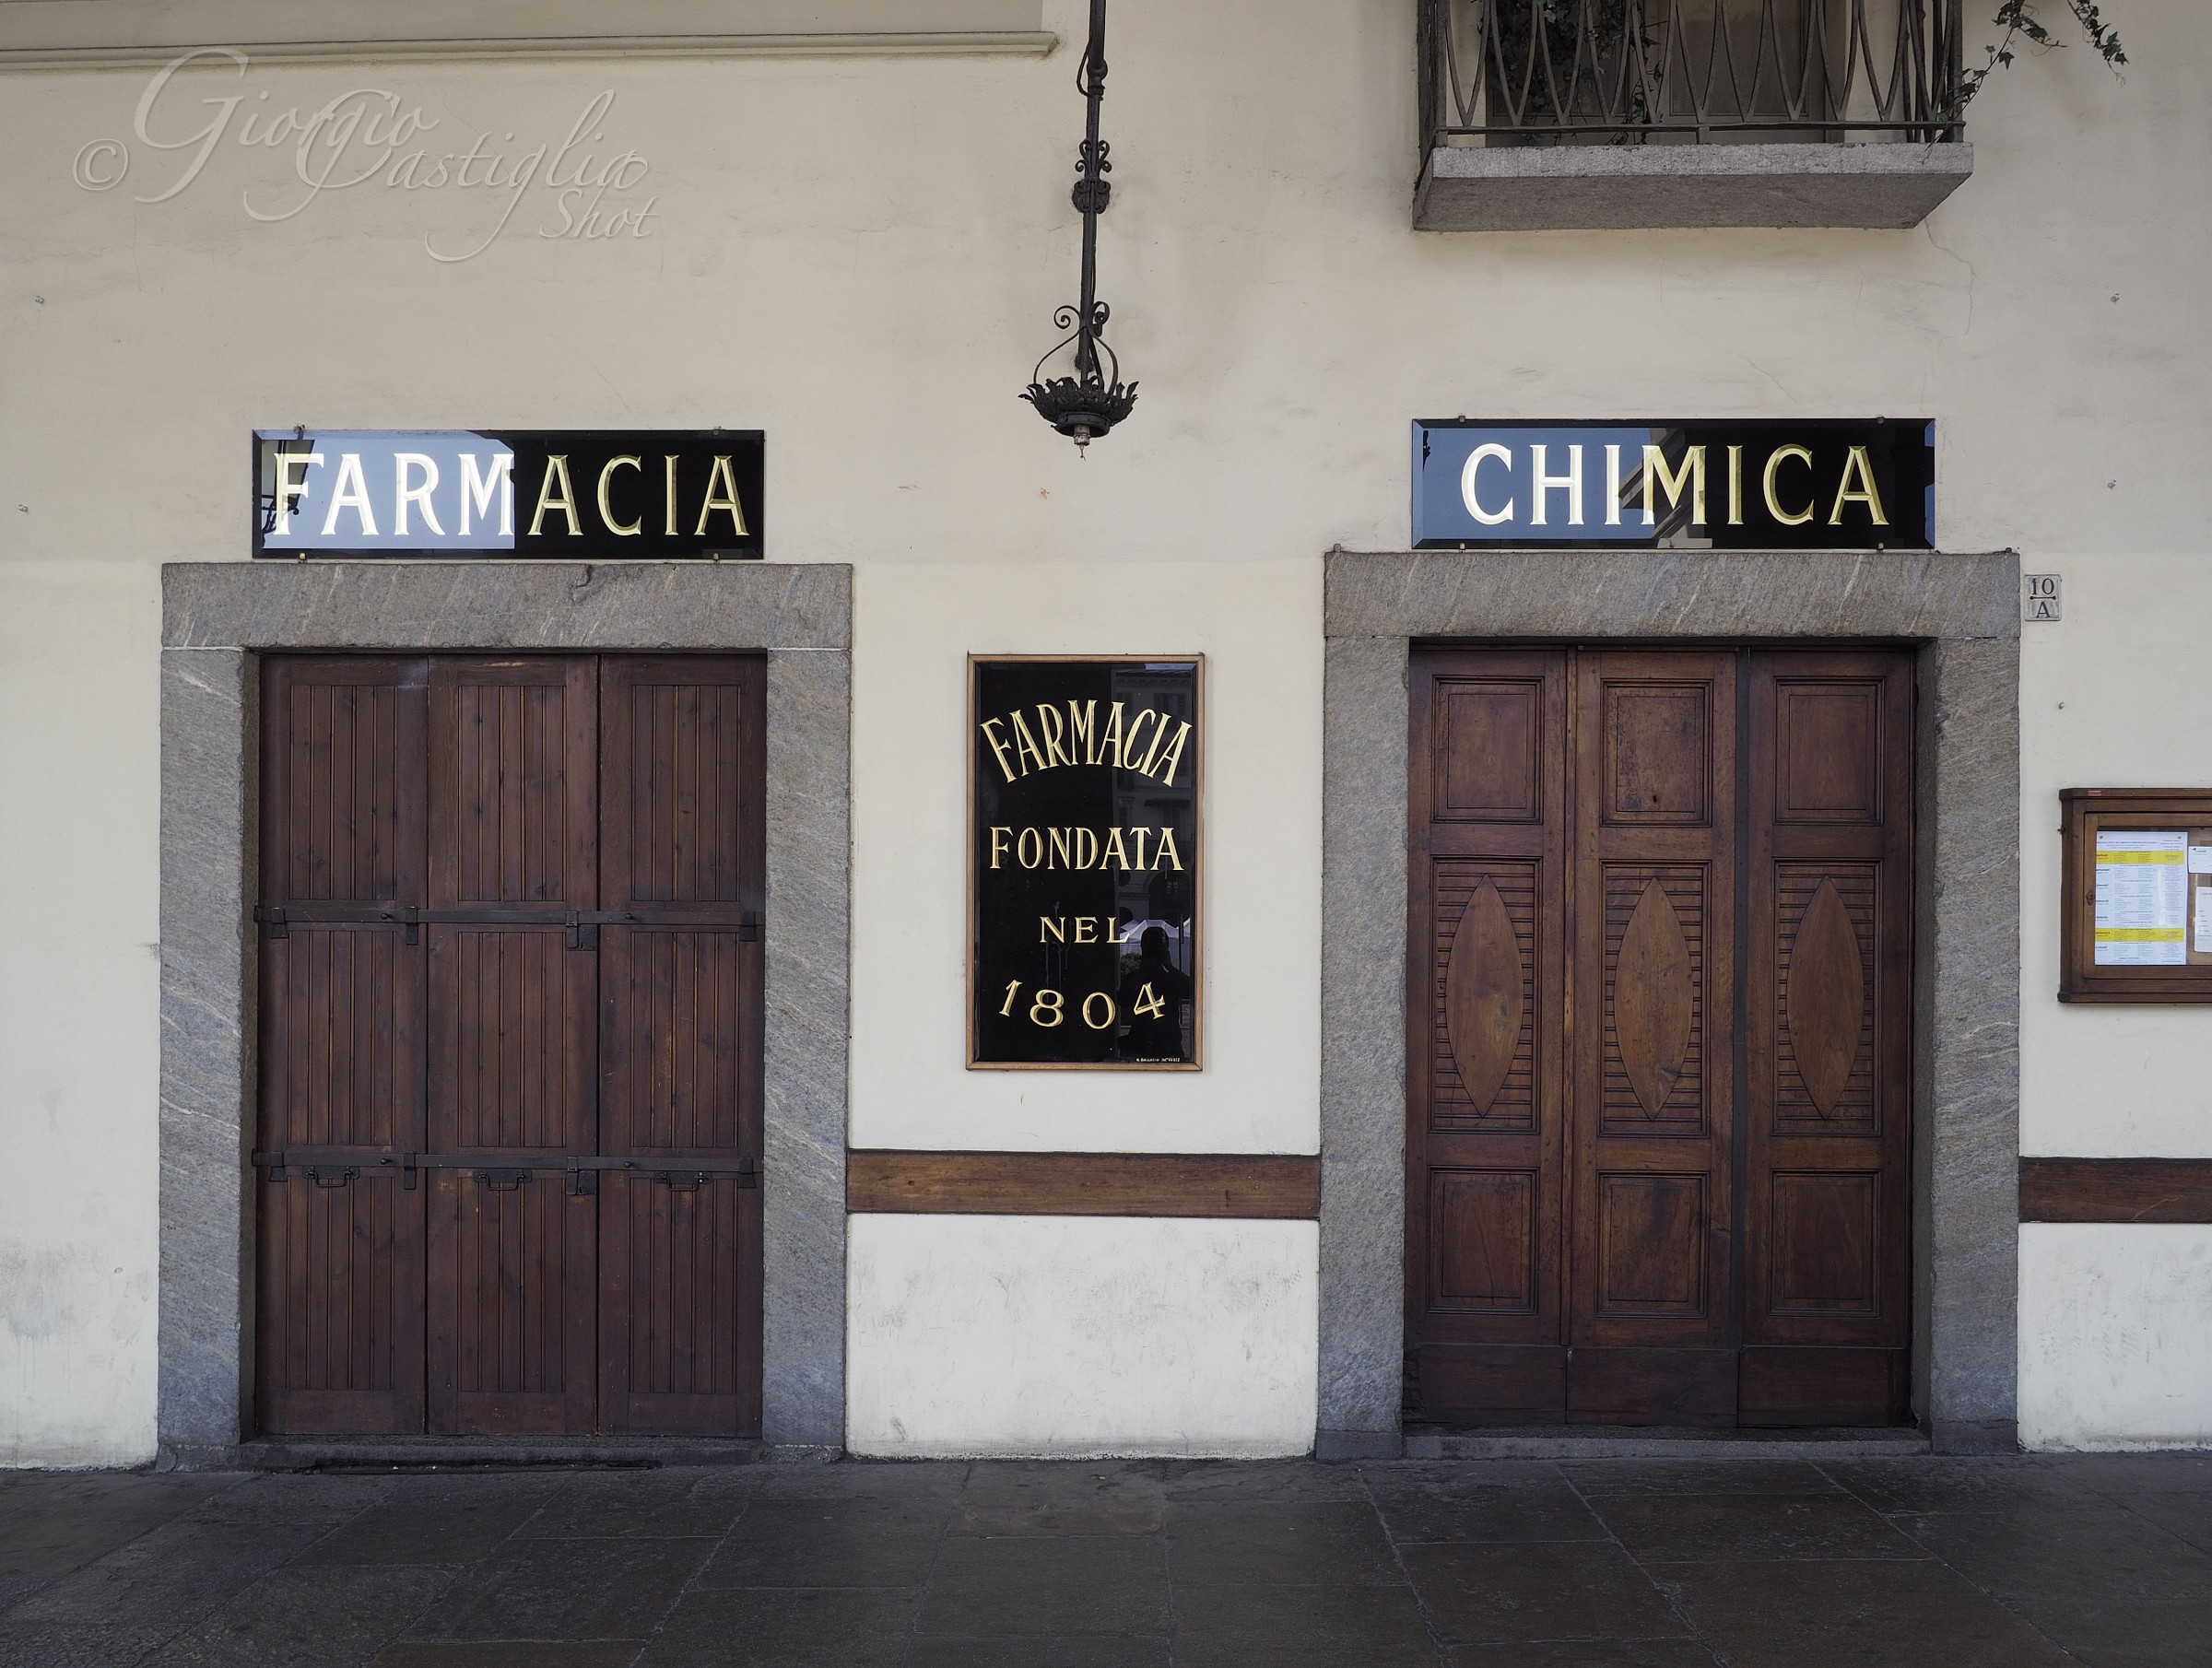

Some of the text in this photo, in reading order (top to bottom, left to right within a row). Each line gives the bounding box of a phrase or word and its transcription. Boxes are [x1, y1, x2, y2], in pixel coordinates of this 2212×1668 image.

[273, 452, 750, 537] FARMACIA
[1460, 442, 1890, 526] CHIMICA
[2030, 578, 2055, 595] 10
[2036, 601, 2052, 618] A
[980, 699, 1193, 788] FARMACIA
[989, 826, 1185, 871] FONDATA
[1039, 916, 1131, 944] NEL
[998, 979, 1167, 1029] 1804
